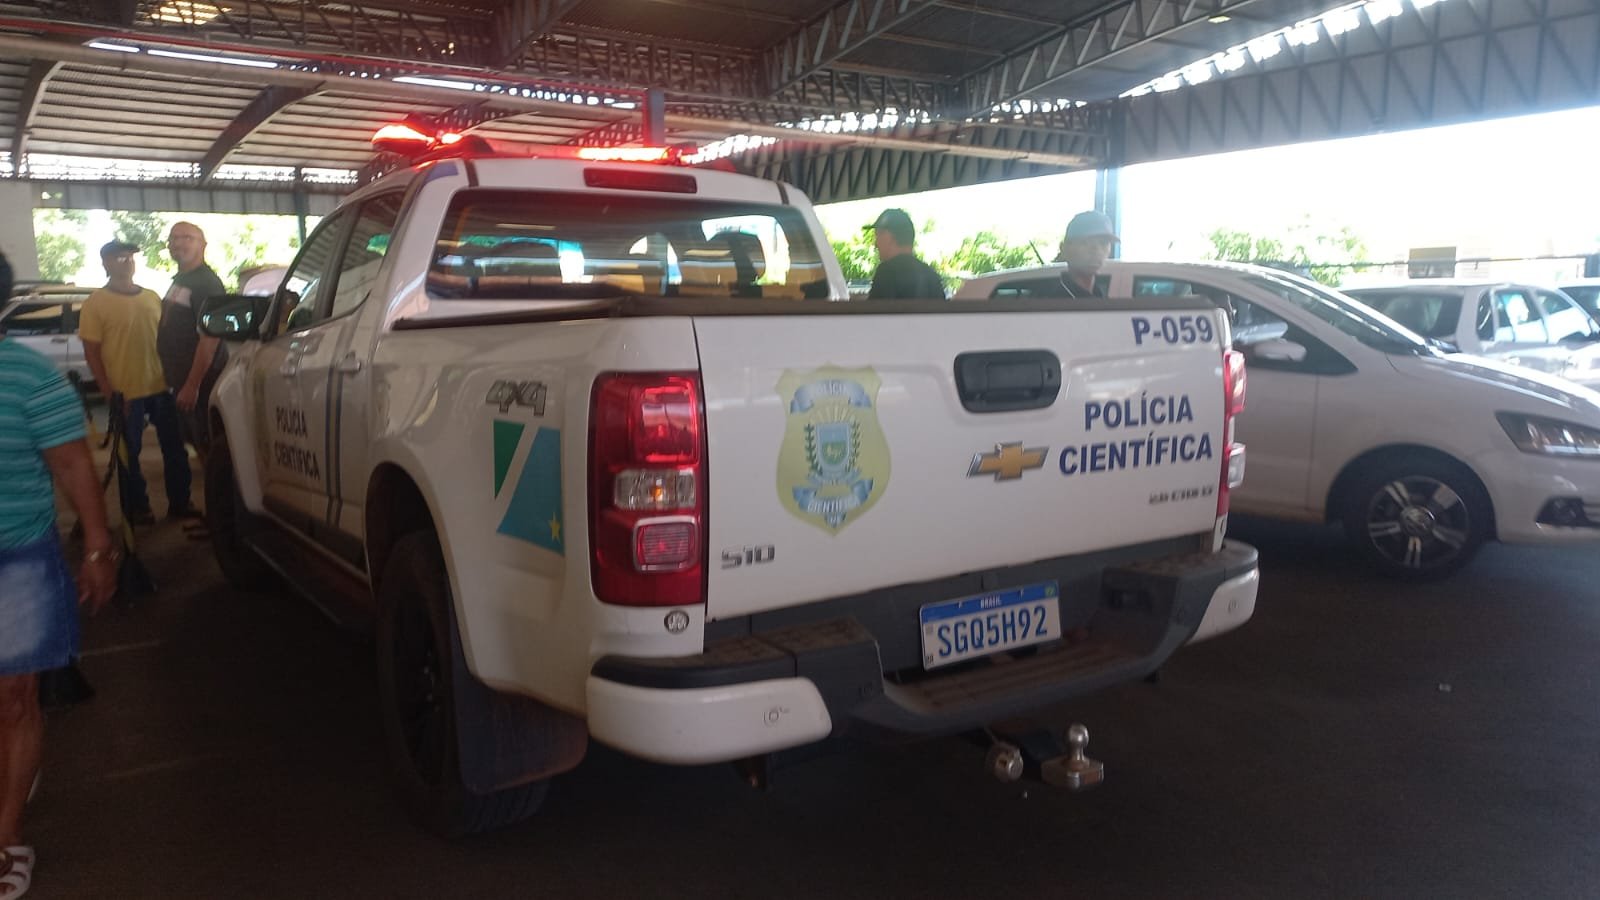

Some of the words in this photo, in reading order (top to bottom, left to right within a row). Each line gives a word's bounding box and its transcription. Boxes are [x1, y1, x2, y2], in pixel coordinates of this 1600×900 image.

[1131, 315, 1214, 345] P-059
[1084, 391, 1193, 431] POLÍCIA
[1058, 431, 1213, 476] CIENTÍFICA
[721, 544, 775, 570] S10
[937, 605, 1048, 657] SGQ5H92
